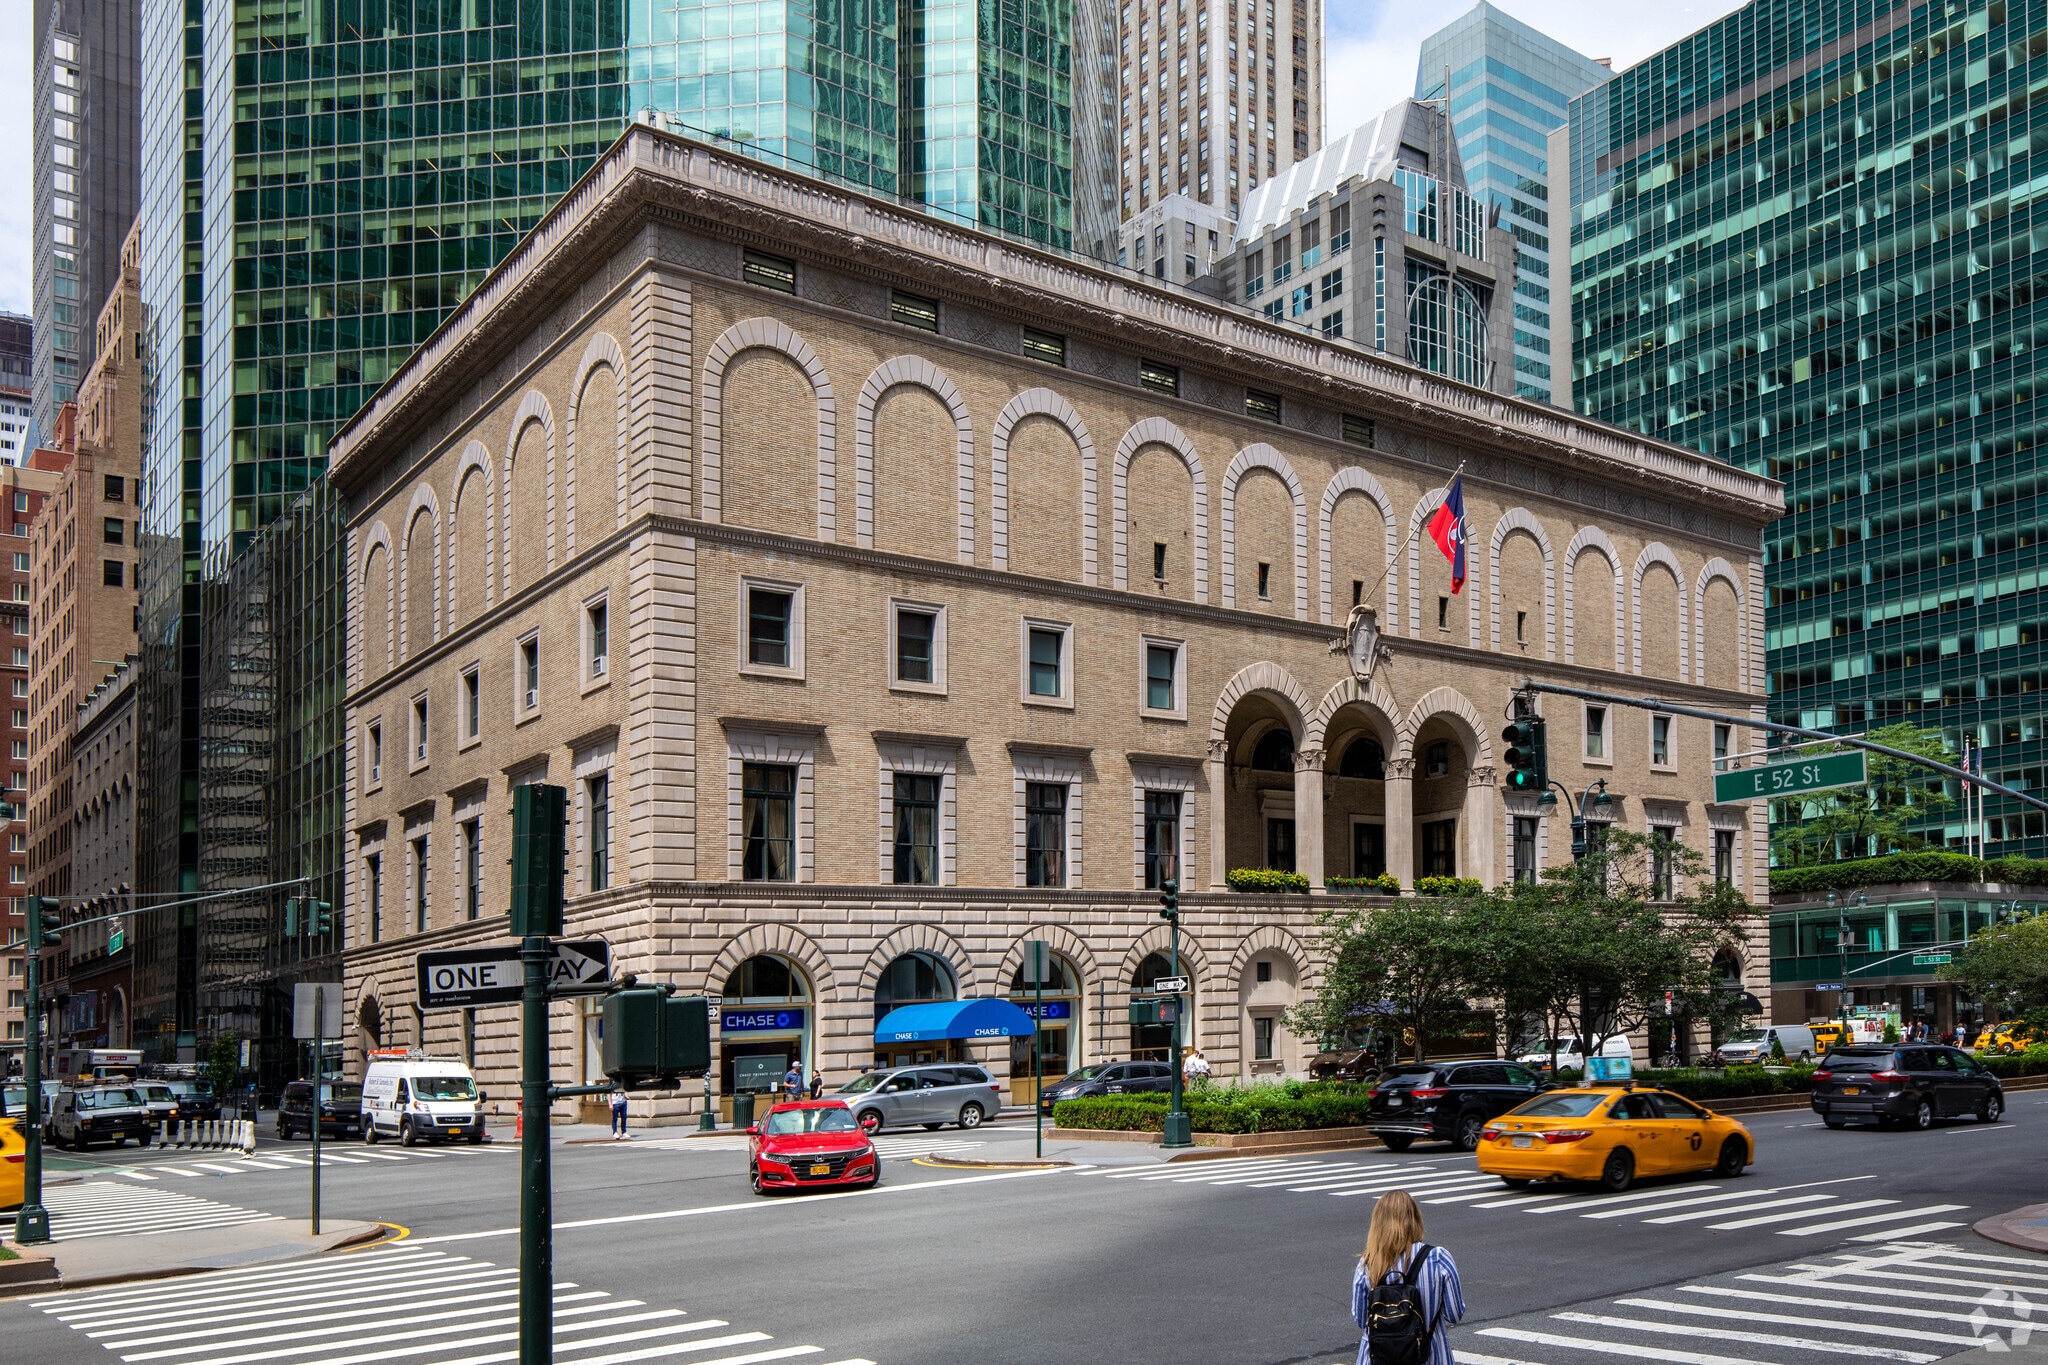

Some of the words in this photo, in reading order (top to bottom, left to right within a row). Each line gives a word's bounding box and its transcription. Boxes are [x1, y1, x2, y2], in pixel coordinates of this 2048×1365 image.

[1754, 773, 1764, 792] E
[1772, 768, 1794, 789] 52
[1802, 765, 1820, 784] St
[435, 965, 497, 990] ONE
[549, 958, 588, 981] AY
[1022, 1006, 1048, 1017] ASE
[726, 1014, 776, 1027] CHASE
[895, 1032, 913, 1040] CHASE
[974, 1028, 1000, 1036] CHASE
